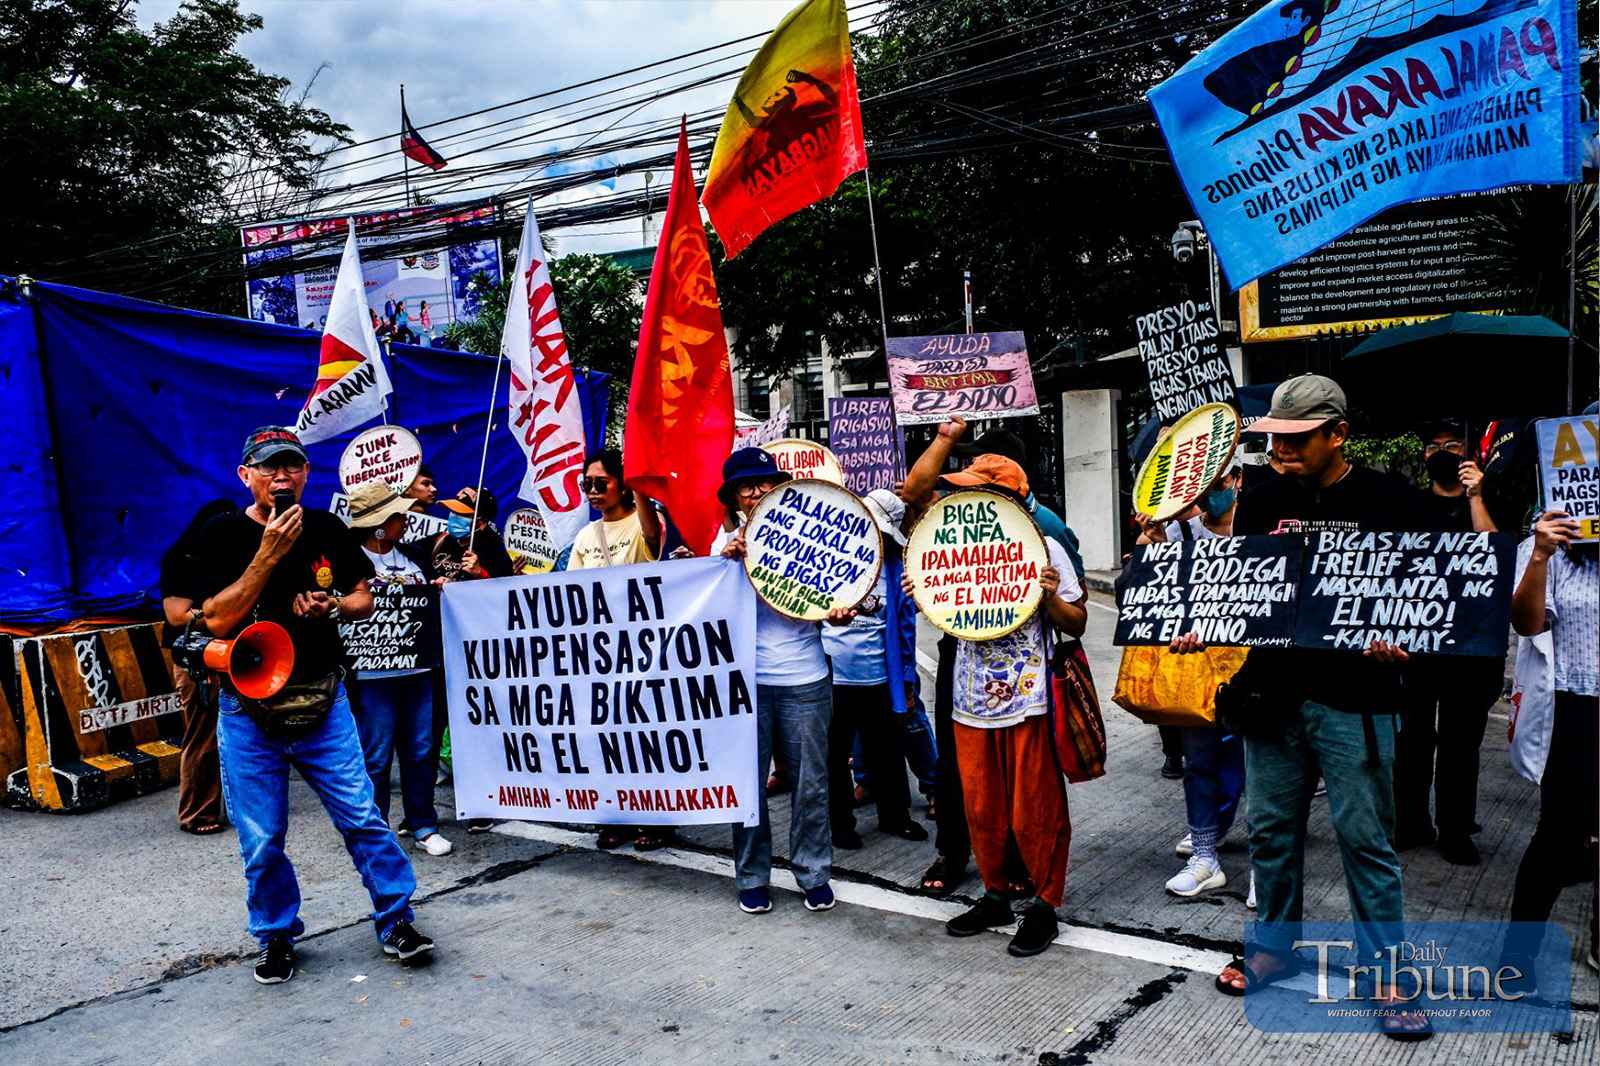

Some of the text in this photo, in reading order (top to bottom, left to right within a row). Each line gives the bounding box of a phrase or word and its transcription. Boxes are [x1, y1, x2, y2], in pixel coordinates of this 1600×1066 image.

[1337, 238, 1377, 248] modernize
[1379, 233, 1419, 244] agriculture
[1422, 231, 1436, 240] and
[1310, 255, 1324, 263] and
[1325, 252, 1356, 262] improve
[1408, 244, 1440, 254] systems
[1279, 268, 1308, 278] develop
[1310, 265, 1340, 274] efficient
[1342, 263, 1374, 273] logistics
[1376, 260, 1408, 270] systems
[1423, 256, 1443, 266] input
[1279, 280, 1309, 290] improve
[1312, 278, 1325, 287] and
[1327, 276, 1355, 287] expand
[1357, 274, 1384, 283] market
[1386, 271, 1413, 281] access
[1280, 292, 1309, 302] balance
[1311, 291, 1323, 299] the
[1325, 288, 1374, 299] development
[1376, 285, 1390, 294] and
[1392, 282, 1431, 294] regulatory
[1433, 281, 1448, 289] role
[1280, 305, 1313, 314] maintain
[1321, 302, 1346, 313] strong
[1347, 299, 1391, 310] partnership
[1393, 297, 1409, 306] with
[1136, 300, 1196, 340] PRESYO
[1280, 314, 1304, 323] sector
[918, 336, 991, 356] AYUDA
[1138, 317, 1219, 362] PALAY ITAAS
[1147, 343, 1218, 379] PRESYO NG
[922, 371, 998, 389] BIKTIMA
[1150, 357, 1230, 401] BIGAS IBABA
[832, 401, 892, 417] LIBREN
[912, 391, 952, 411] EL
[1156, 387, 1208, 422] NGAYON
[1209, 380, 1235, 404] NA
[833, 416, 894, 435] IRIGASYO
[355, 433, 397, 457] JUNK
[345, 453, 420, 486] LIBERALIZATION
[361, 450, 391, 469] RICE
[1168, 437, 1193, 499] TIGILAN!
[1183, 433, 1210, 504] KORAPSYON
[1148, 454, 1172, 507] AMIHAN
[1558, 467, 1599, 483] PARA
[779, 487, 870, 539] PALAKASIN
[943, 501, 999, 525] BIGAS
[511, 524, 548, 541] PESTE
[763, 508, 876, 565] ANG LOKAL NA
[934, 521, 1011, 546] NG NFA,
[1317, 531, 1431, 554] BIGAS NG
[754, 524, 866, 585] PRODUKSYON
[921, 542, 1024, 571] IPAMAHAGI
[1142, 536, 1246, 563] NFA RICE
[758, 553, 845, 595] NG BIGAS!
[924, 561, 1038, 588] SA MGA BIKTIMA
[1147, 556, 1287, 587] SA BODEGA
[1310, 551, 1498, 576] I-RELIEF SA MGA
[750, 566, 835, 611] BANTAY BIGAS
[758, 583, 810, 617] AMIHAN
[933, 582, 1031, 606] NG EL NIÑO!
[1123, 586, 1184, 606] ILABAS
[1312, 576, 1495, 600] NASALANTA NG
[400, 597, 428, 608] KILO
[508, 576, 666, 631] AYUDA AT
[1120, 602, 1272, 621] SA MGA BIKTIMA
[1330, 596, 1456, 628] EL NIÑO!
[369, 609, 412, 624] IGAS
[1128, 623, 1153, 640] NG
[463, 619, 735, 680] KUMPENSASYON
[352, 654, 418, 670] KADAMAY
[136, 698, 171, 717] MRT
[466, 670, 753, 726] SA MGA BIKTIMA
[503, 728, 709, 774] NG EL NINO!
[499, 785, 739, 812] AMIHAN KMP PAMALAKAYA
